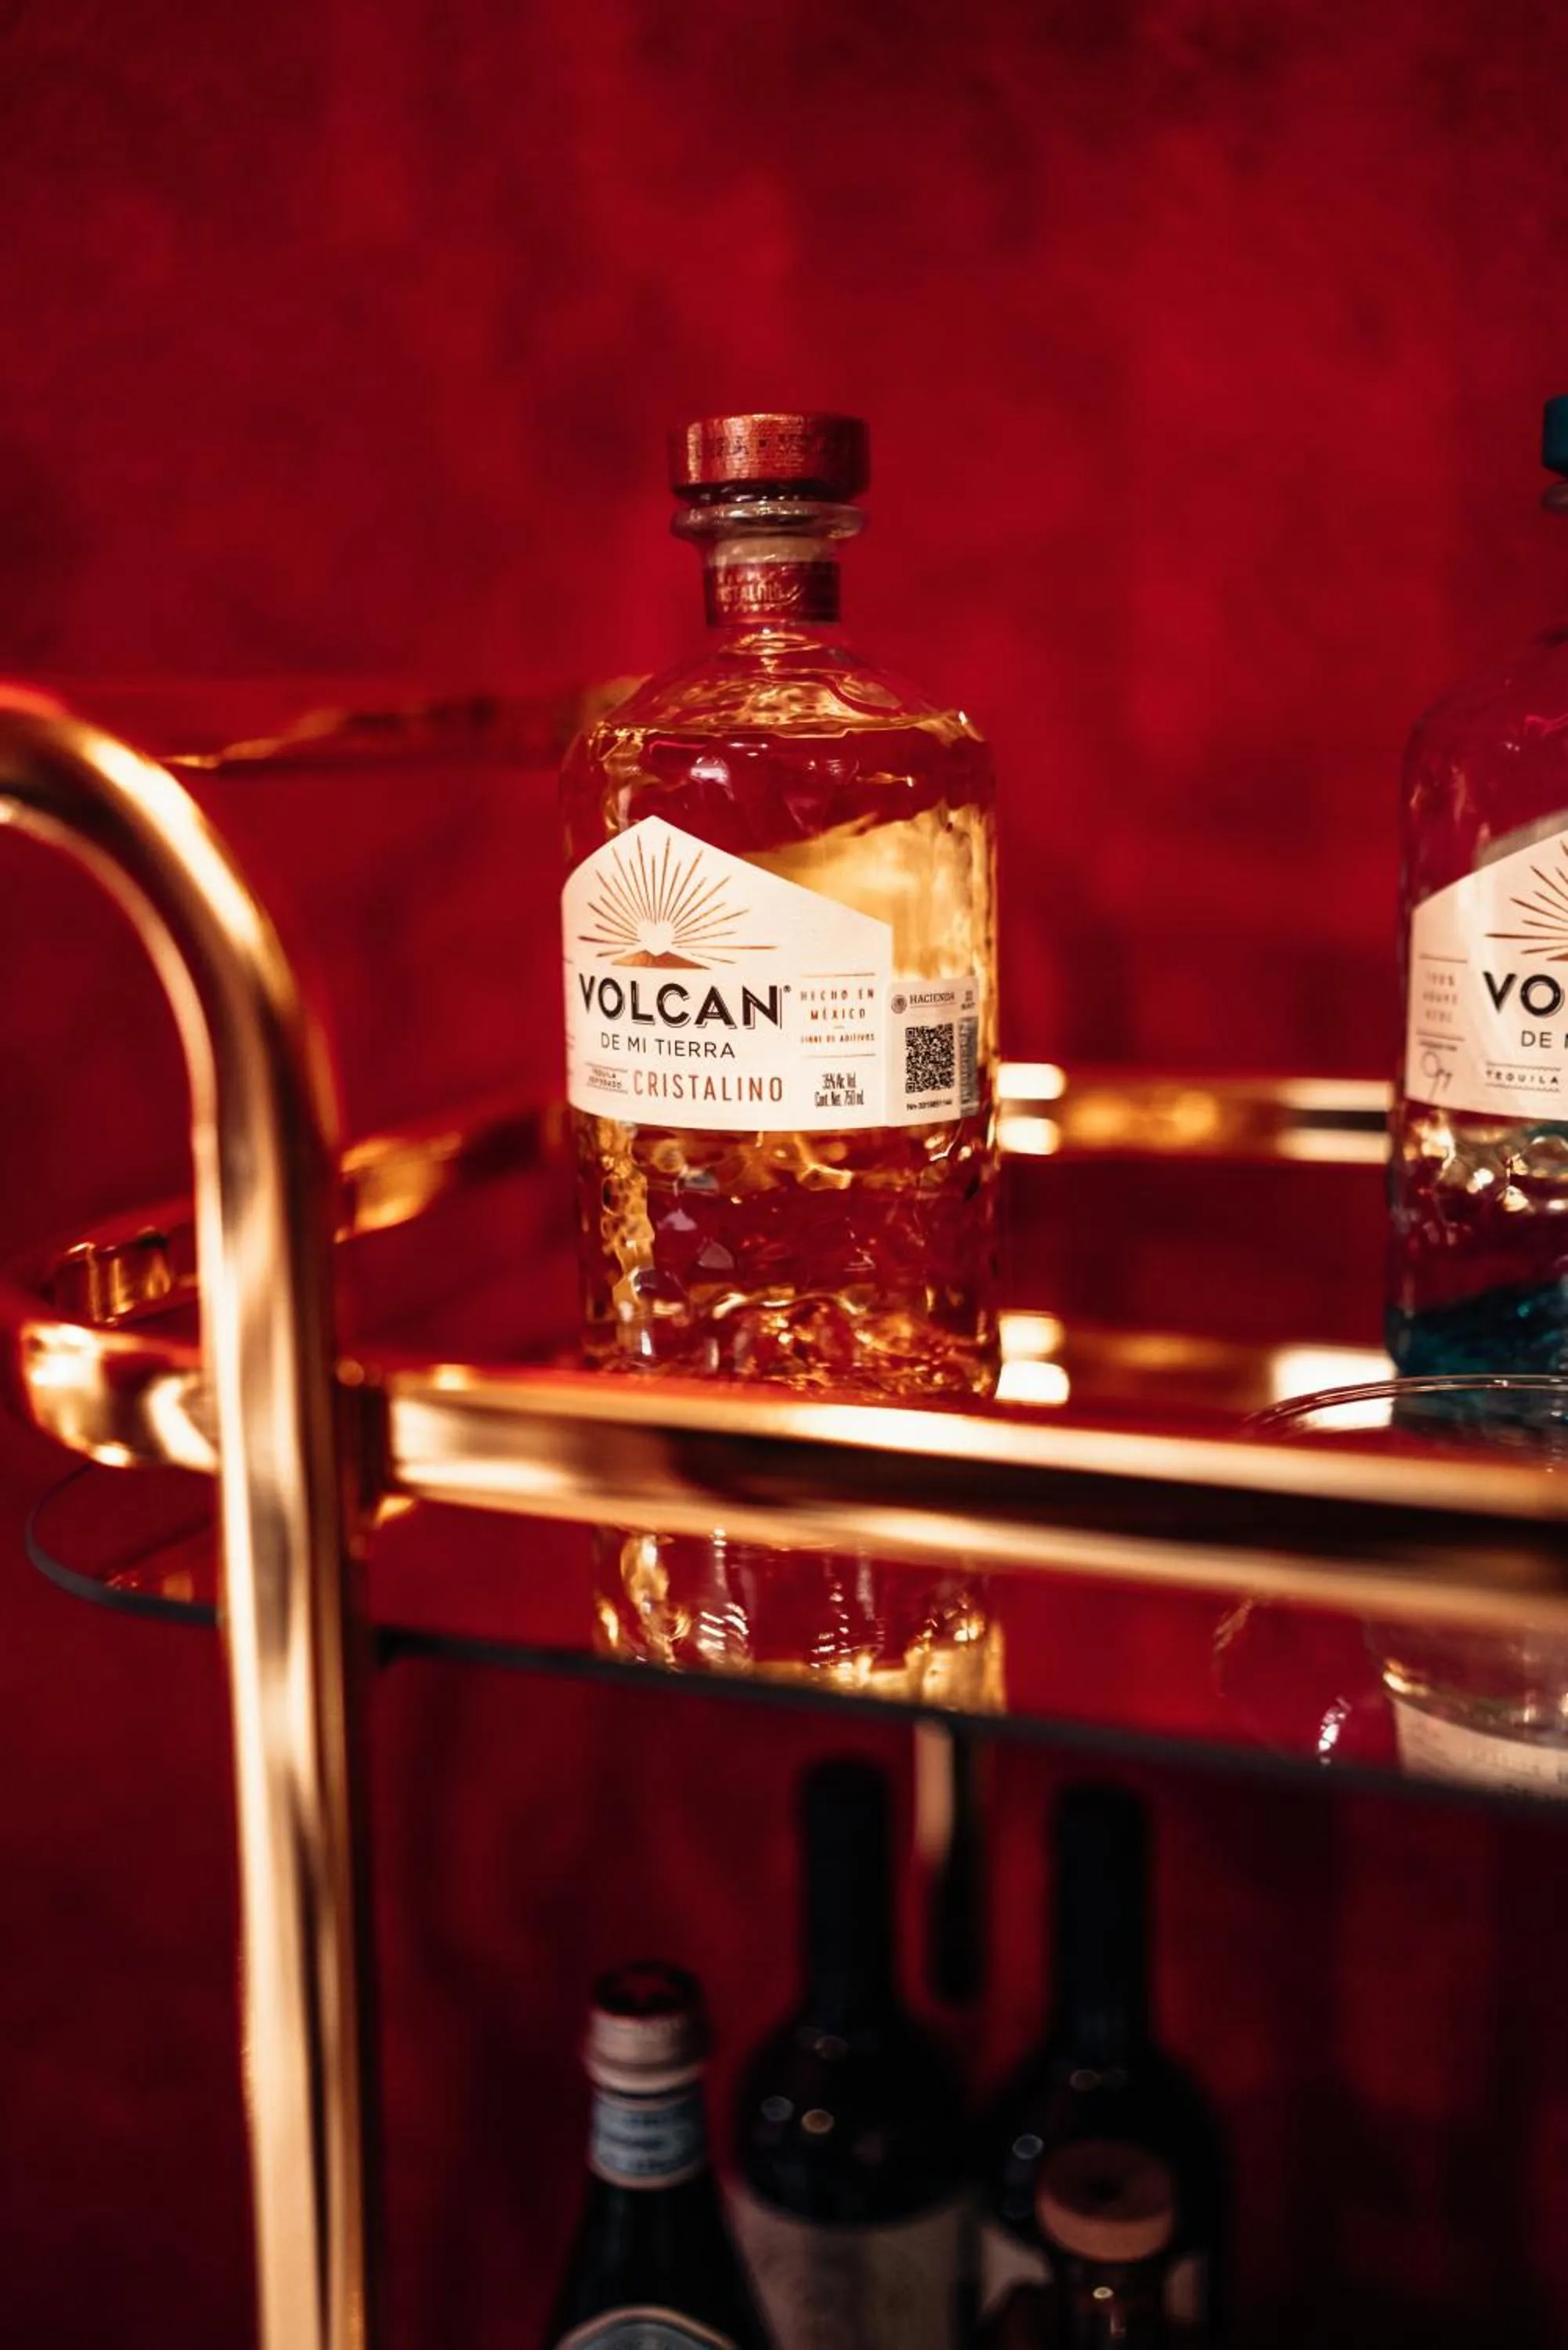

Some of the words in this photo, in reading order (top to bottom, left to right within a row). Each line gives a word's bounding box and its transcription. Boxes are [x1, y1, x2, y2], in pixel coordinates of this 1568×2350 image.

[579, 973, 781, 1029] VOLCAN
[909, 992, 956, 1004] HACIENDA
[1483, 971, 1565, 1018] VO
[601, 1032, 620, 1050] DE
[627, 1036, 646, 1054] MI
[654, 1038, 735, 1059] TIERRA
[1520, 1030, 1552, 1048] DE
[633, 1068, 783, 1103] CRISTALINO
[1486, 1069, 1559, 1086] TEQUILA
